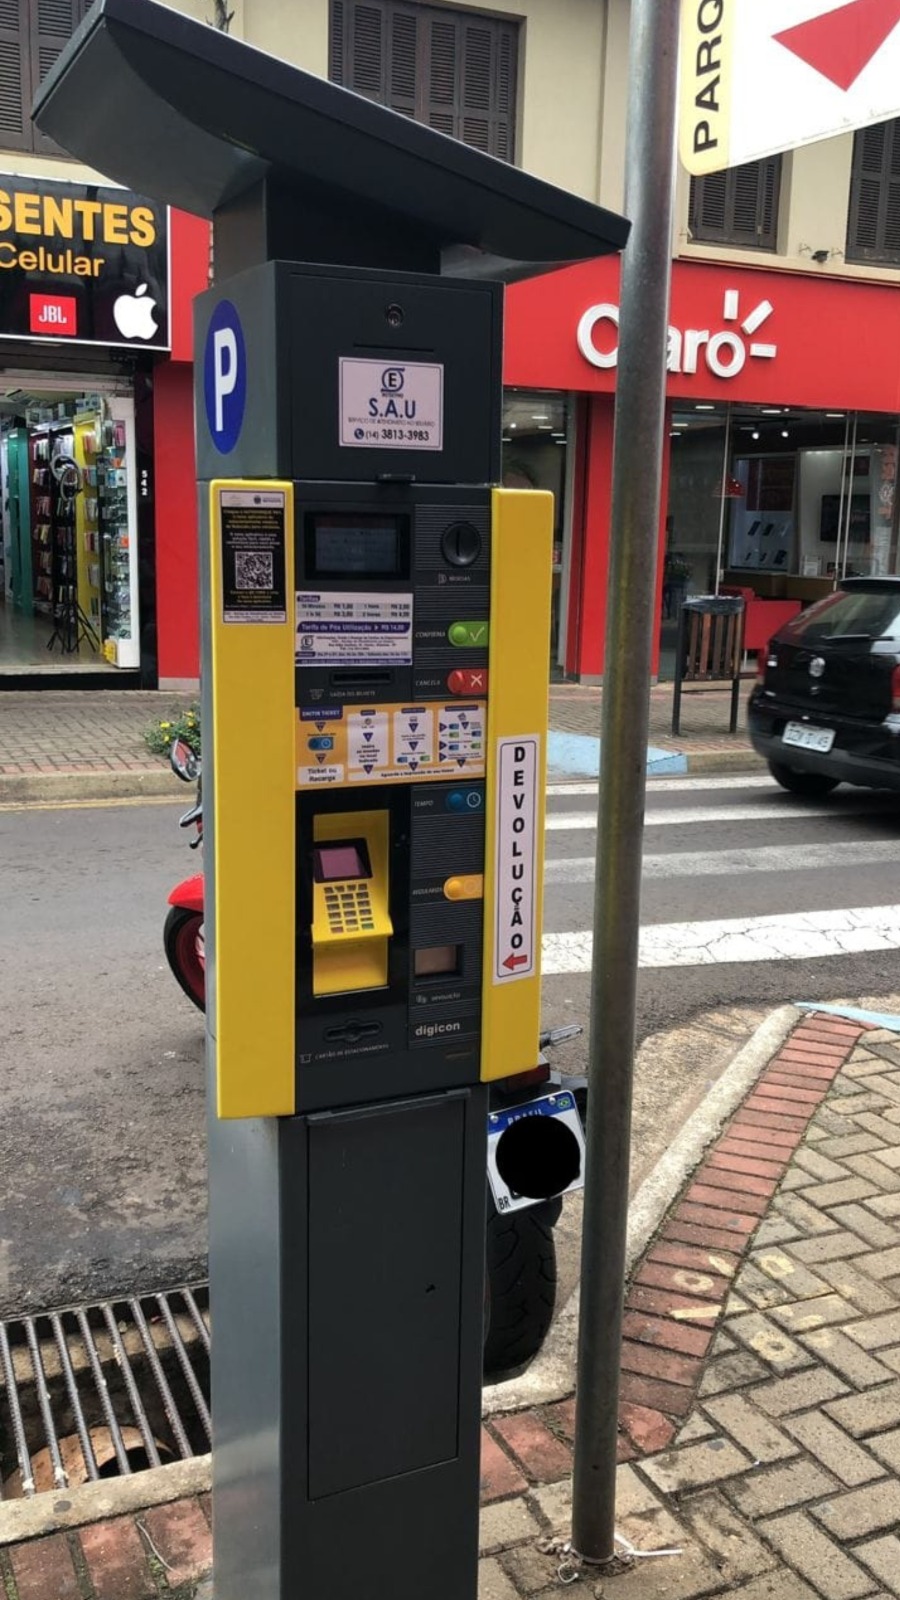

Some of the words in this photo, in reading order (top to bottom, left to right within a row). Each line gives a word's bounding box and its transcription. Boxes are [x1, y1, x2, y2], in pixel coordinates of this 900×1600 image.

[0, 241, 105, 277] Celular
[38, 305, 67, 324] JBL
[577, 302, 746, 378] Caro
[213, 327, 237, 432] P
[368, 397, 416, 419] S.A.U
[365, 430, 379, 441] (14)
[381, 429, 430, 441] 3813-3983
[510, 745, 526, 949] DEVOLUÇÃO
[415, 1021, 460, 1037] digicon
[498, 1196, 511, 1211] BR
